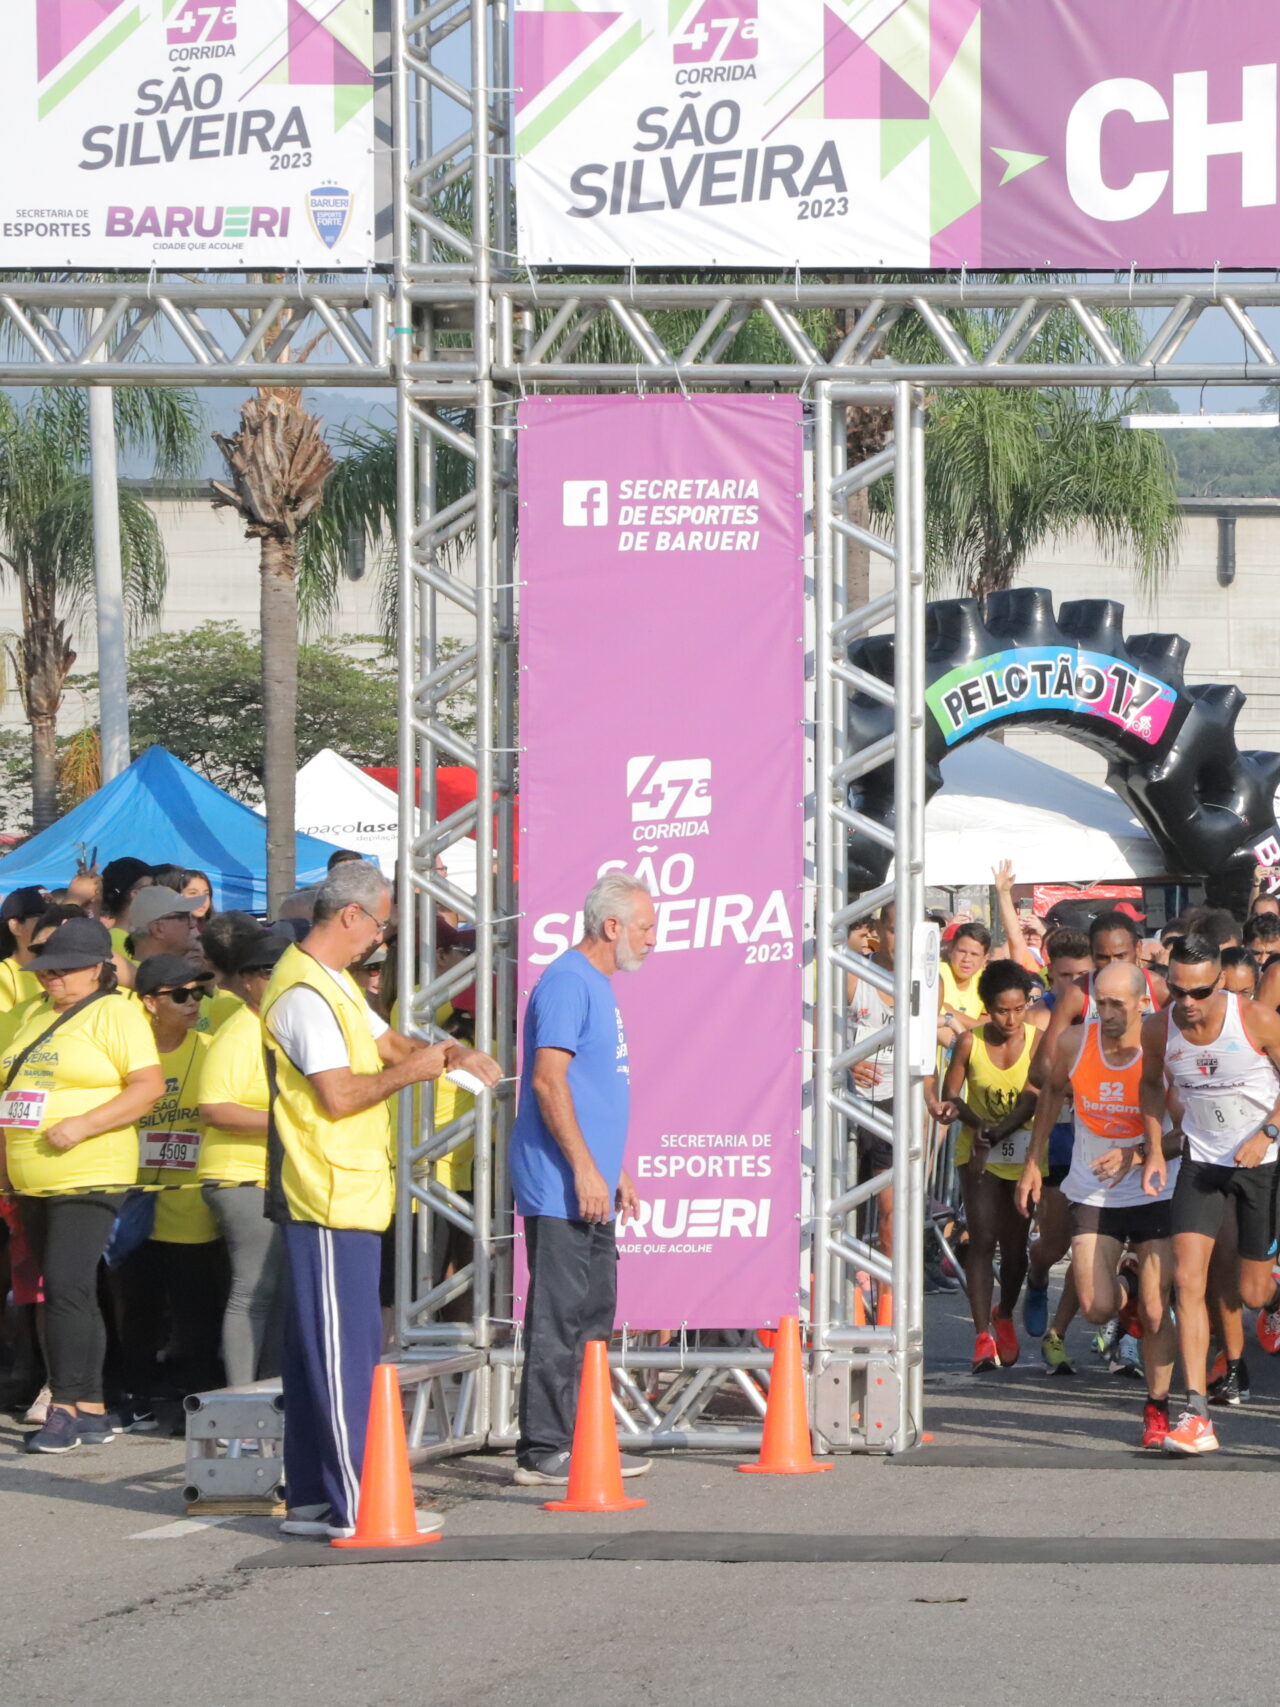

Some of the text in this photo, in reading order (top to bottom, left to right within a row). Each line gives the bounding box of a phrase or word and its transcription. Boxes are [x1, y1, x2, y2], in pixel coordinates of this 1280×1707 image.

[169, 44, 236, 62] CORRIDA
[675, 64, 757, 86] CORRIDA
[134, 66, 223, 116] SÃO
[633, 91, 742, 152] SÃO
[78, 106, 312, 171] SILVEIRA
[269, 152, 312, 171] 2023
[566, 140, 849, 218] SILVEIRA
[16, 209, 89, 218] SECRETARIA DE
[797, 197, 849, 220] 2023
[3, 223, 91, 237] ESPORTES
[105, 206, 290, 237] BARUERI
[153, 242, 244, 251] CIDADE QUE ACOLHE
[619, 480, 760, 499] SECRETARIA
[619, 505, 759, 525] DE ESPORTES
[618, 531, 760, 551] DE BARUERI
[632, 821, 709, 841] CORRIDA
[745, 942, 793, 964] 2023
[1099, 1082, 1124, 1097] 52
[8, 1102, 31, 1119] 4334
[153, 1099, 178, 1113] SÃO
[138, 1107, 200, 1128] SILVEIRA
[1215, 1110, 1225, 1123] 8
[661, 1134, 772, 1148] SECRETARIA DE
[1002, 1143, 1014, 1157] 55
[160, 1143, 187, 1160] 4509
[638, 1155, 772, 1178] ESPORTES
[615, 1199, 771, 1238] RUERI
[644, 1244, 666, 1254] QUE
[668, 1244, 713, 1253] ACOLHE
